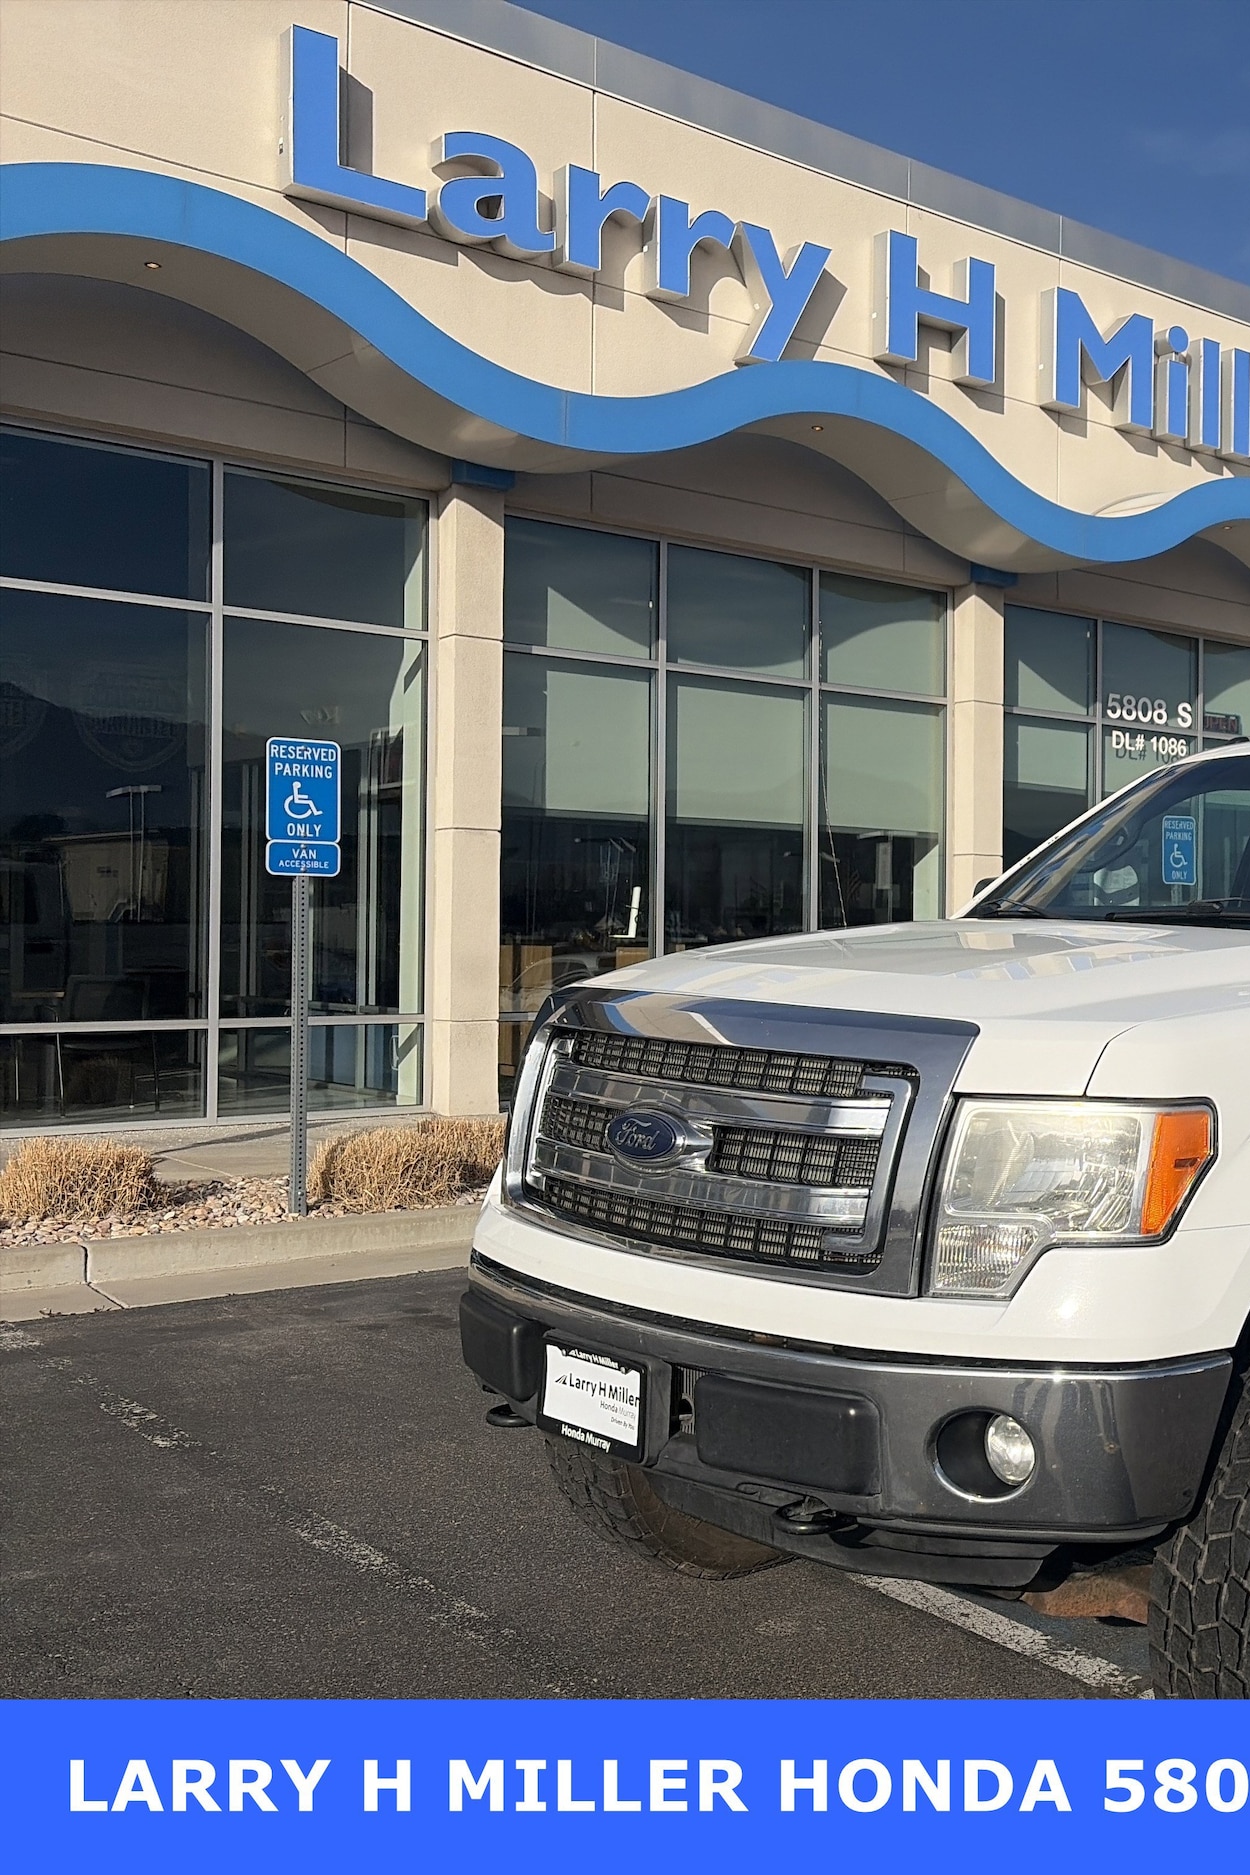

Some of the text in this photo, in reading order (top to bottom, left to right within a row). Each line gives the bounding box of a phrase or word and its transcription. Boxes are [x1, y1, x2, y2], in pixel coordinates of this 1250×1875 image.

[286, 22, 832, 363] Larry
[880, 229, 996, 385] H
[1106, 692, 1192, 728] 5808 S
[1111, 730, 1187, 757] DL# 1086
[270, 744, 337, 762] RESERVED
[274, 762, 333, 779] PARKING
[286, 823, 322, 837] ONLY
[1164, 820, 1194, 830] RESERVED
[1165, 831, 1193, 841] PARKING
[292, 848, 317, 860] VAN
[278, 859, 329, 869] ACCESSIBLE
[1171, 870, 1188, 880] ONLY
[615, 1118, 660, 1151] Ford
[575, 1349, 593, 1363] Larry
[599, 1355, 619, 1369] Miller
[569, 1373, 640, 1408] Larry H Miller
[600, 1400, 619, 1414] Honda
[561, 1424, 611, 1453] Honda Murray
